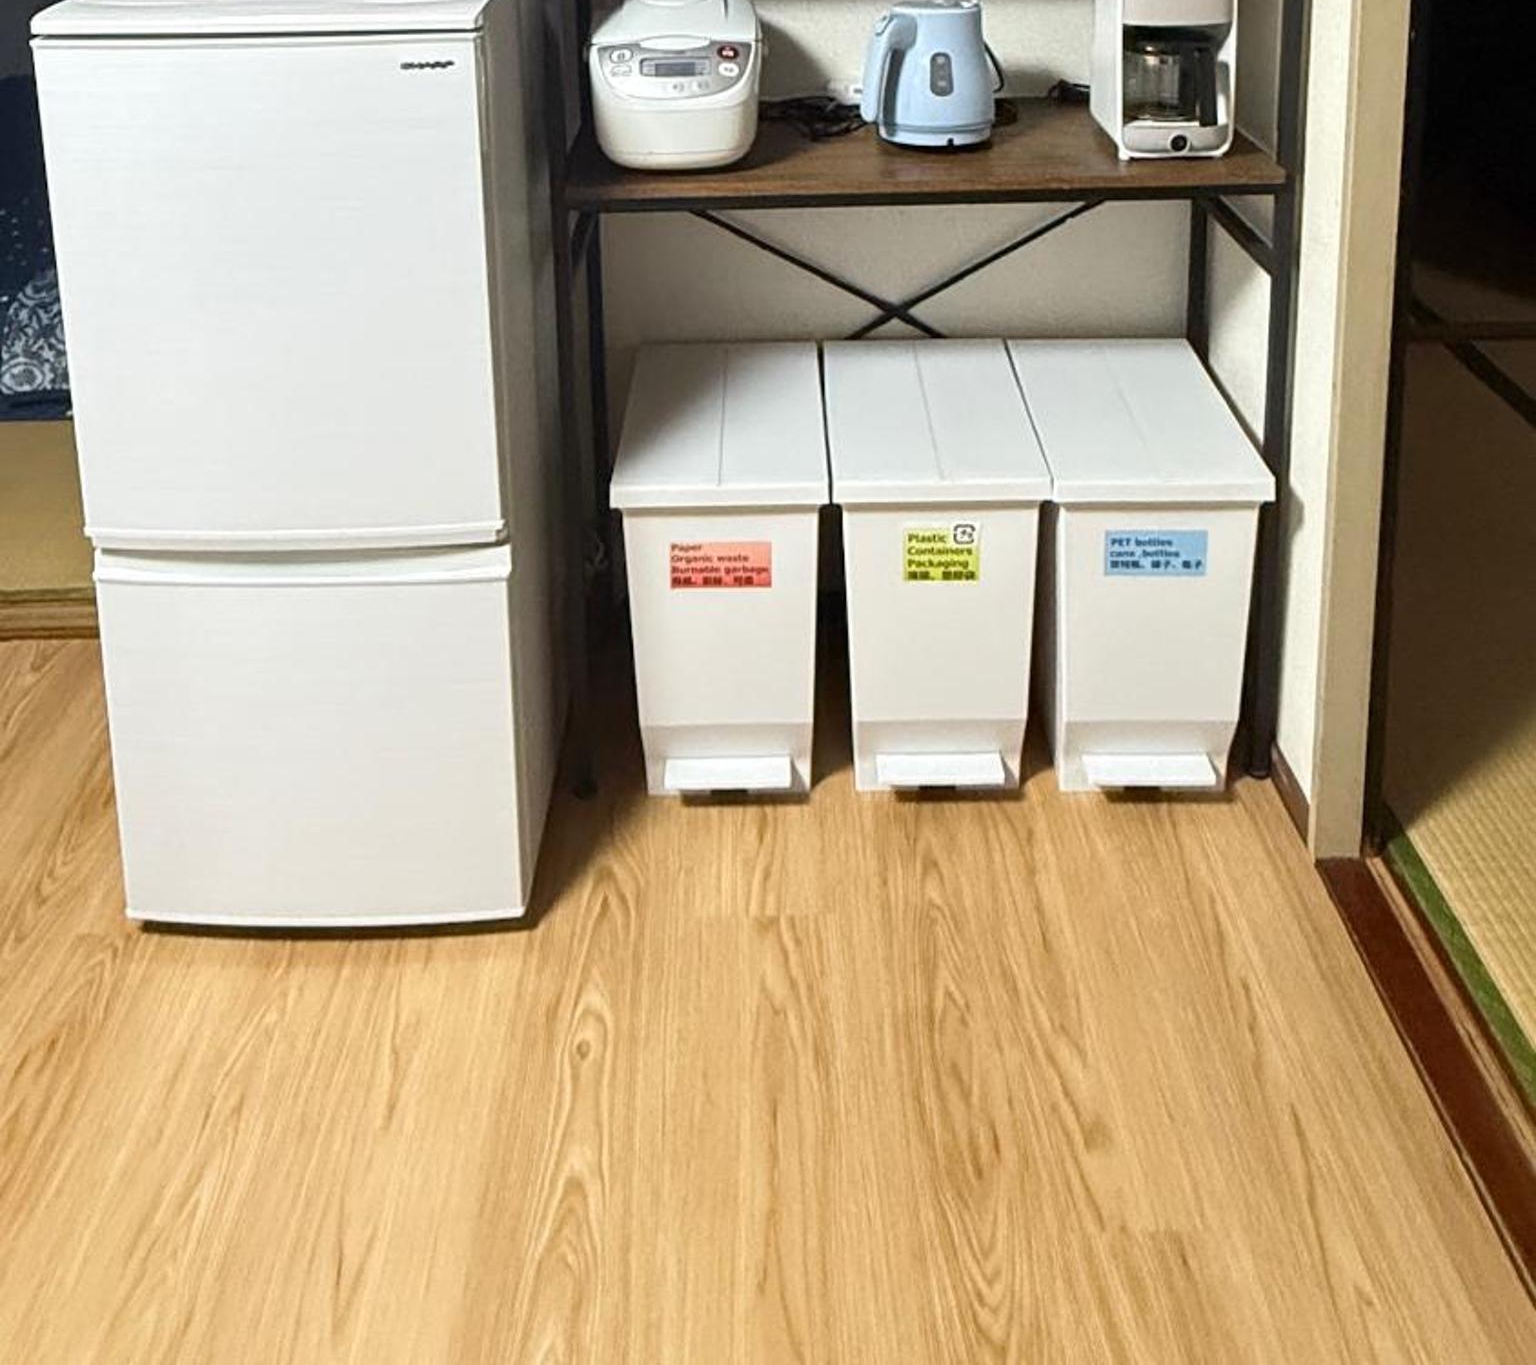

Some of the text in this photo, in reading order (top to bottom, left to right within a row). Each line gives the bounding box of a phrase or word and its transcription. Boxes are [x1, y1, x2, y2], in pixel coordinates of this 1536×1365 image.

[908, 534, 946, 543] Plastic
[1110, 537, 1173, 546] PET bottles
[671, 543, 702, 552] Paper
[907, 546, 973, 555] Containers
[671, 554, 750, 564] Organic waste
[907, 559, 969, 569] Packaging
[671, 565, 769, 575] Burnable garbage
